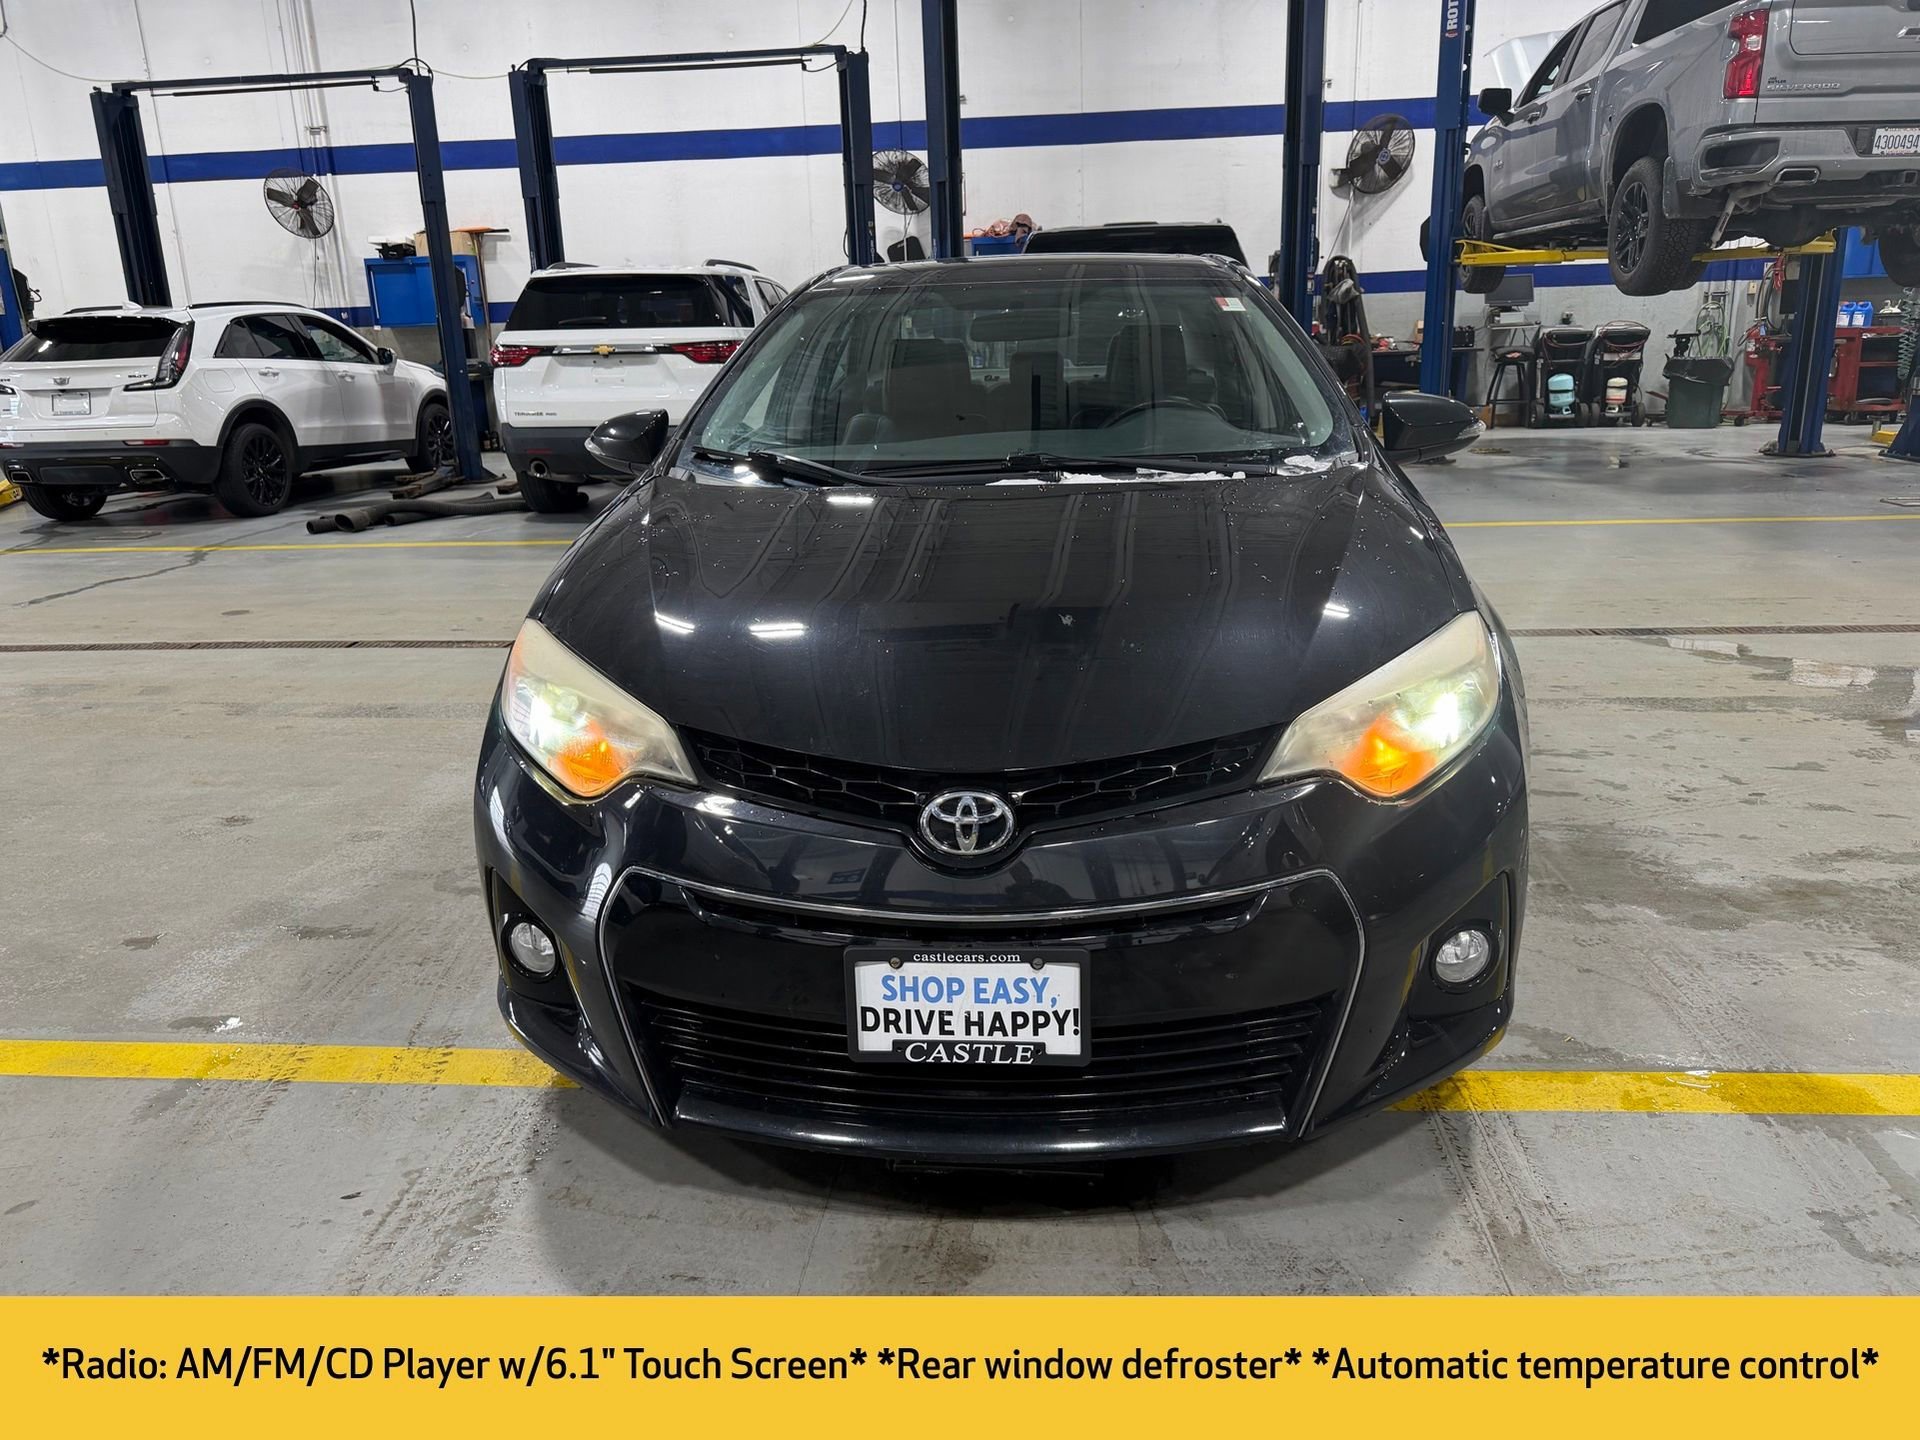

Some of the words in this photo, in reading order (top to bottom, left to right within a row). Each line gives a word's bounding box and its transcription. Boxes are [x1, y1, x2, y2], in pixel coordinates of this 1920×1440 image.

[1874, 134, 1920, 150] 4300494
[912, 952, 1022, 964] castlecars.com
[881, 974, 965, 1004] SHOP
[973, 976, 1060, 1009] EASY,
[860, 1006, 955, 1036] DRIVE
[964, 1007, 1080, 1037] HAPPY!
[904, 1042, 1036, 1065] CASTLE
